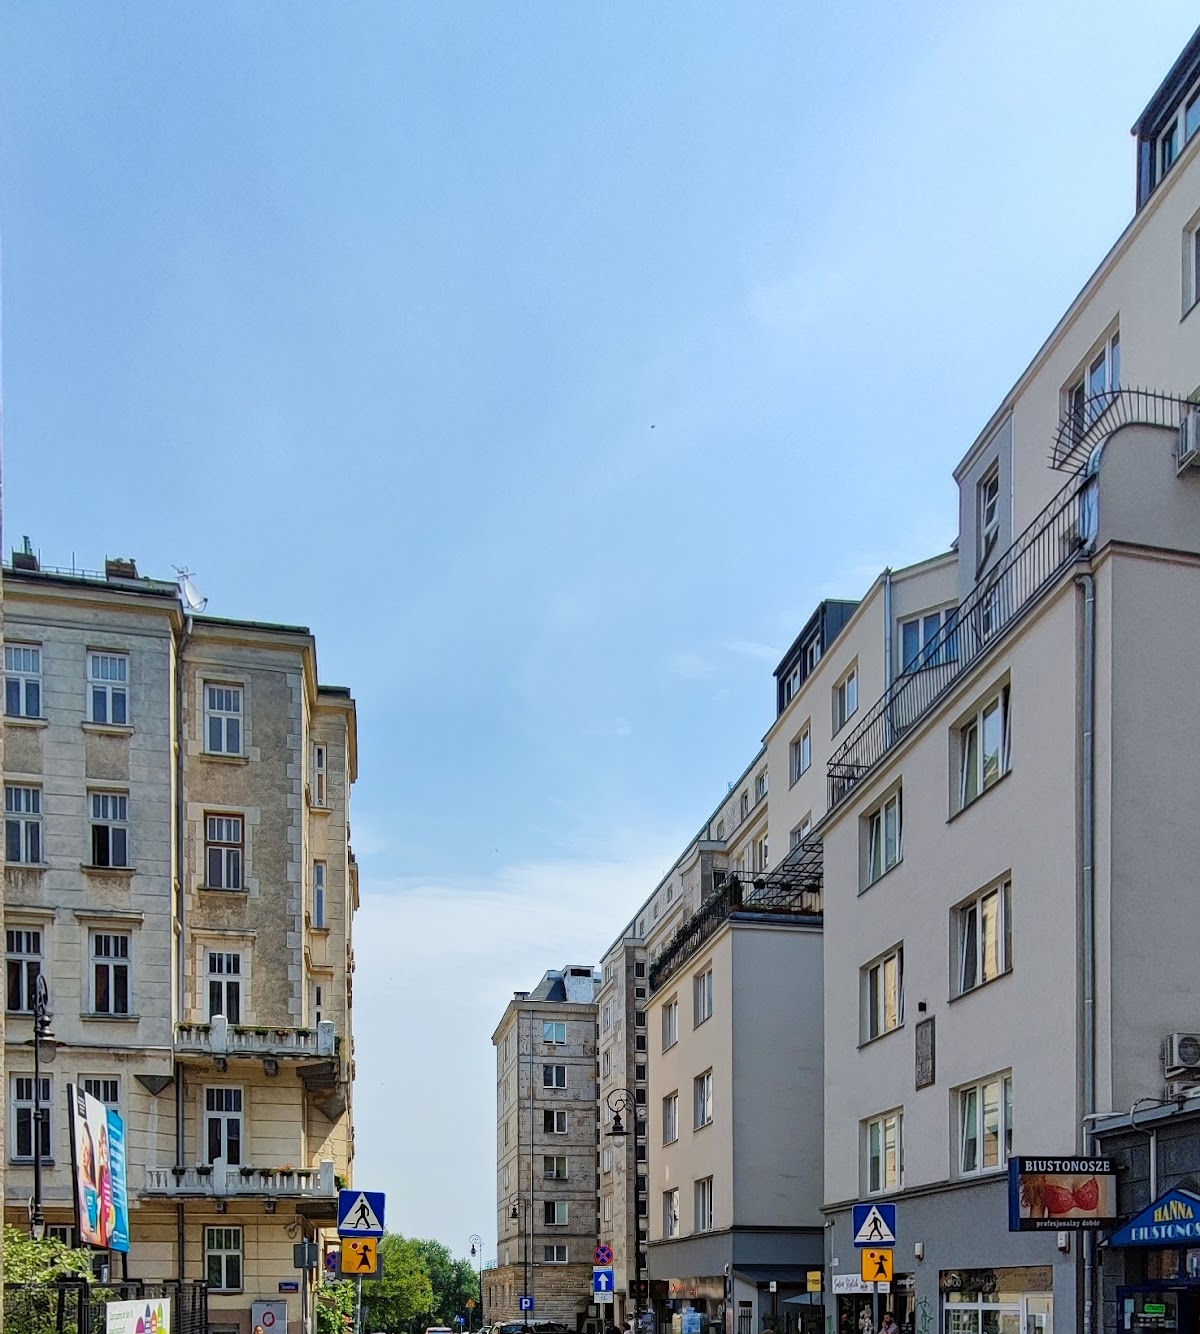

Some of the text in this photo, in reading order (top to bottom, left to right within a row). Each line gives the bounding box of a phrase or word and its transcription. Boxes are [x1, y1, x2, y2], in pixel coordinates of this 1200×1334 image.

[1024, 1160, 1111, 1172] BIUSTONOSZE
[1153, 1200, 1194, 1222] HANNA
[1036, 1219, 1080, 1229] profesjonalny
[521, 1298, 531, 1310] P
